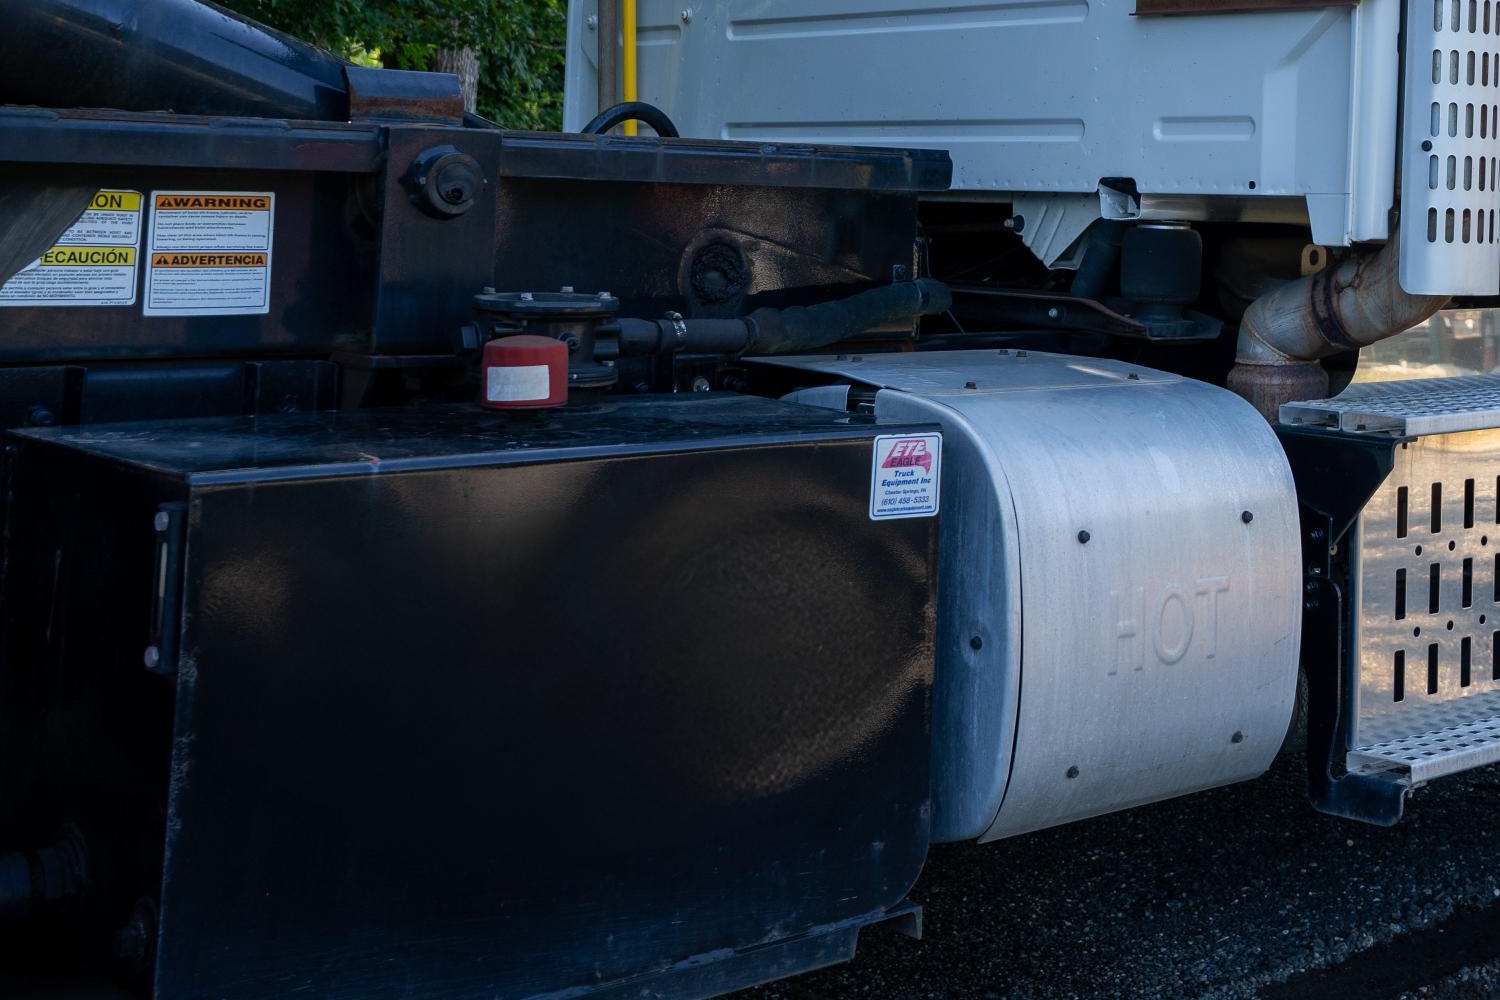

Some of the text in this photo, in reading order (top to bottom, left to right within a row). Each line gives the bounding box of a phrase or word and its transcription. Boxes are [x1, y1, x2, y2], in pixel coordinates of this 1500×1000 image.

[172, 198, 266, 208] WARNING
[40, 249, 128, 263] ECAUCIÓN
[171, 255, 264, 265] ADVERTENCIA
[891, 441, 926, 456] ETE
[890, 456, 921, 467] EAGLE
[894, 470, 915, 478] Truck
[881, 478, 919, 487] Equipment
[881, 497, 897, 506] (610)
[1107, 574, 1231, 677] HOT
